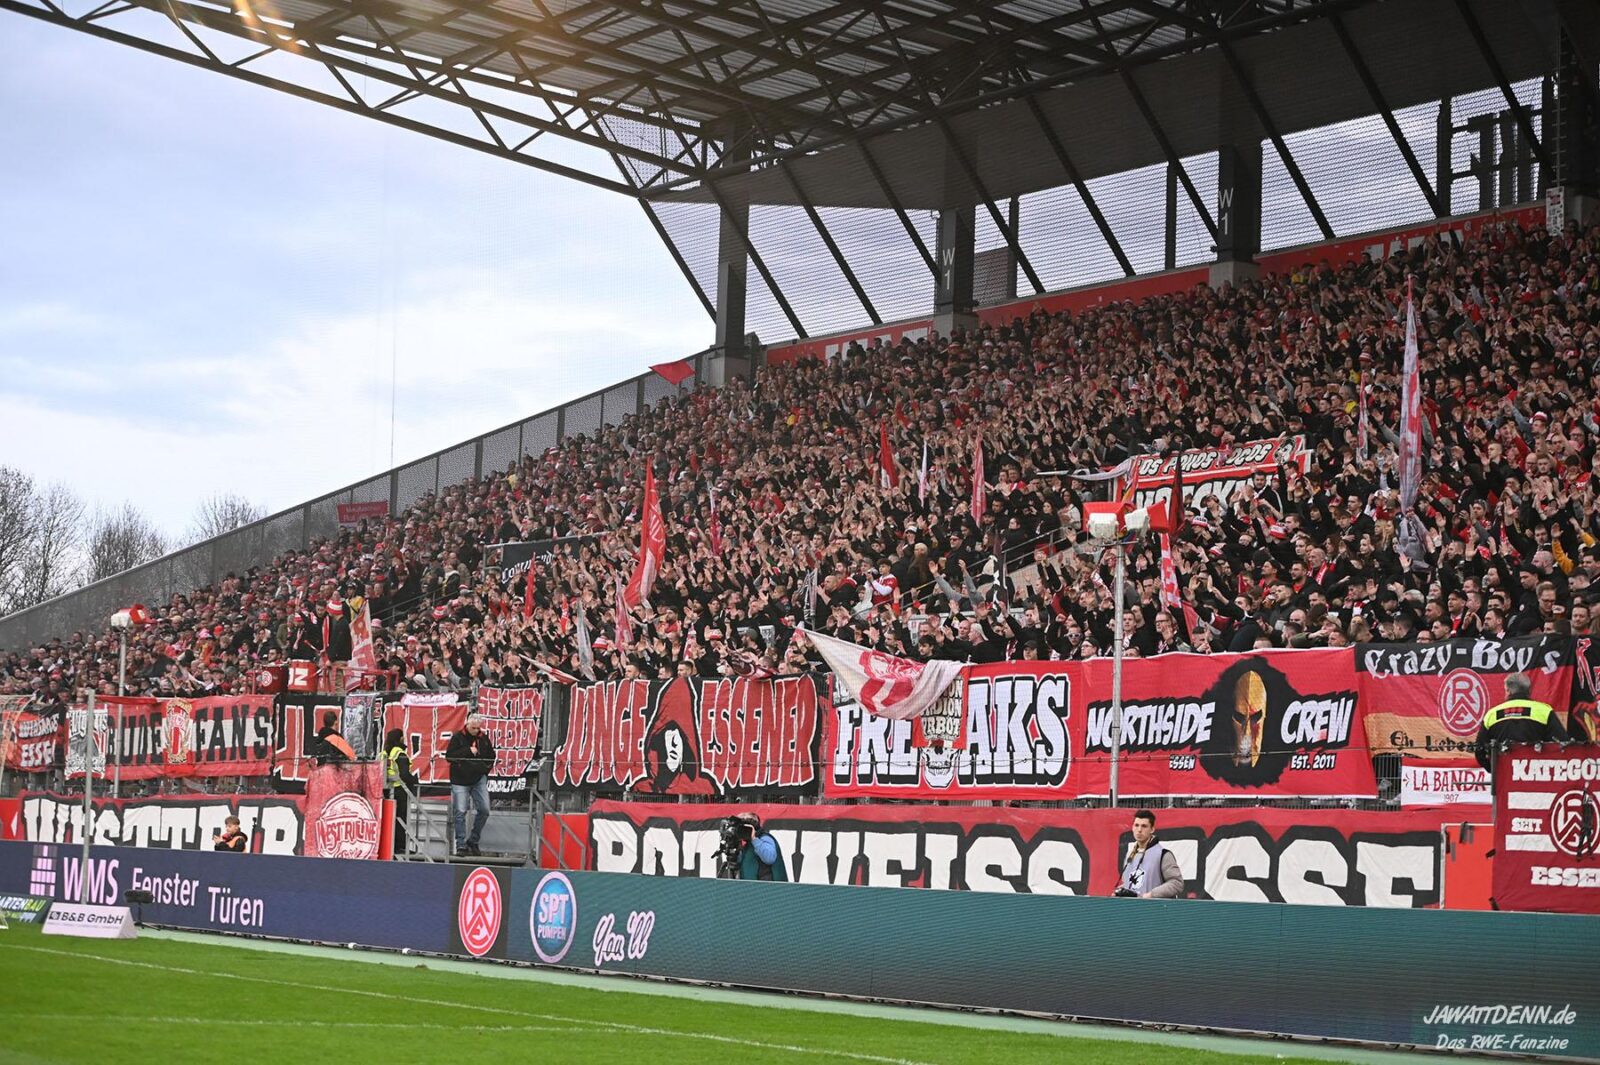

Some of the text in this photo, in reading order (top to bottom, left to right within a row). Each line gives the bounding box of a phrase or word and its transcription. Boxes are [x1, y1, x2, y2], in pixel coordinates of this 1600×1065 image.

[195, 704, 271, 763] FANS
[553, 674, 818, 787] JUNGE ESSENER
[1085, 697, 1355, 748] NORTHSIDE CREW
[1290, 754, 1335, 769] EST. 2011
[1512, 758, 1600, 782] KATEGO
[1413, 770, 1487, 792] LA BANDA
[1443, 794, 1460, 803] 1907
[1511, 817, 1543, 833] SEIT
[1531, 866, 1600, 888] ESSE
[63, 856, 264, 927] WMS Fenster Türen
[0, 894, 46, 912] ARTENBAU
[538, 892, 569, 925] SPT
[61, 911, 124, 925] B&B GmbH
[537, 925, 566, 940] PUMPEN
